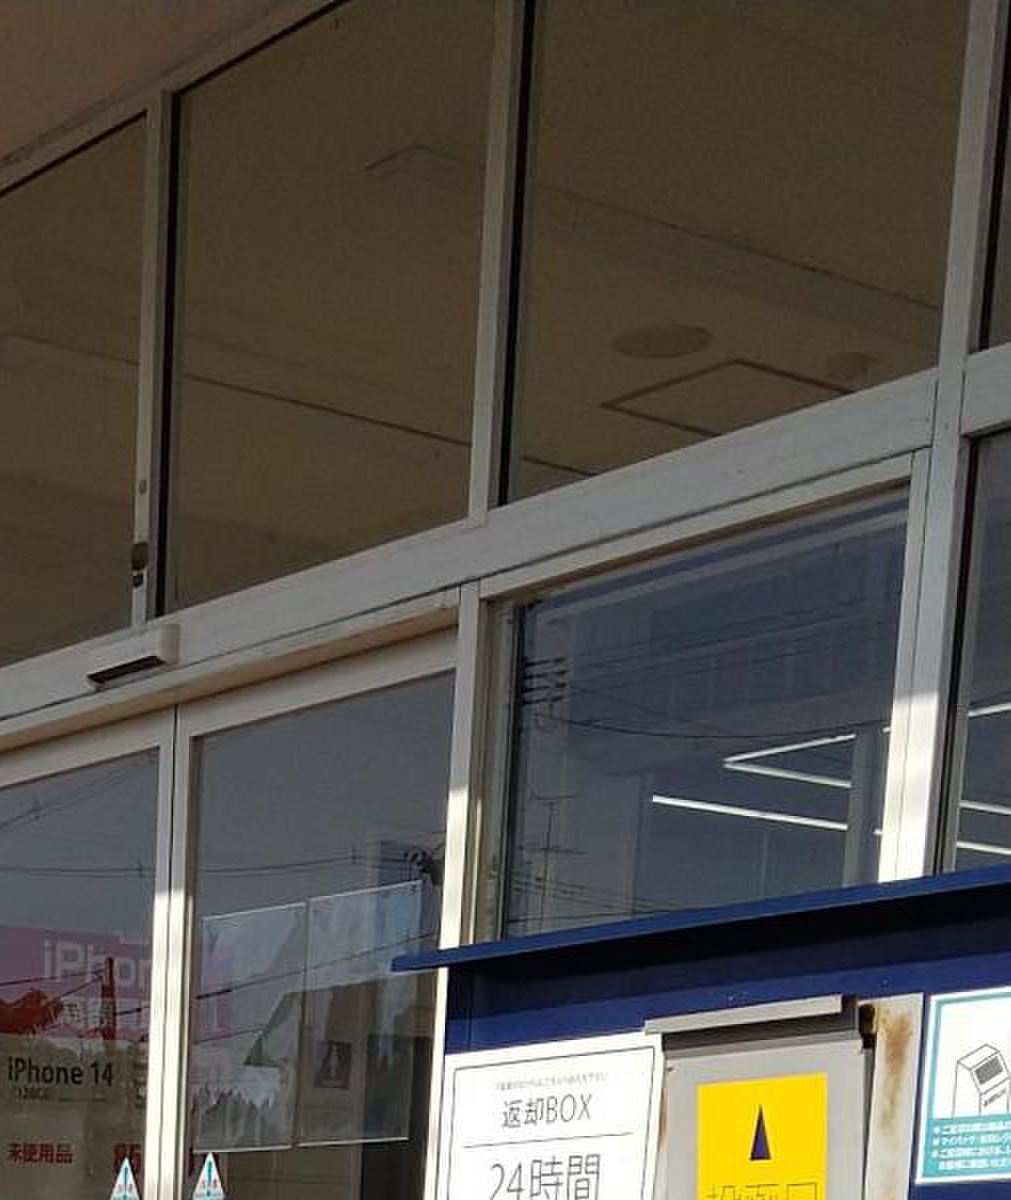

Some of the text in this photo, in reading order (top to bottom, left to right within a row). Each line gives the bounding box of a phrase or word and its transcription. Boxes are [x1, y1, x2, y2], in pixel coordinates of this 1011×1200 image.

[7, 1056, 113, 1087] iPhone 14
[502, 1093, 592, 1128] 返却BOX
